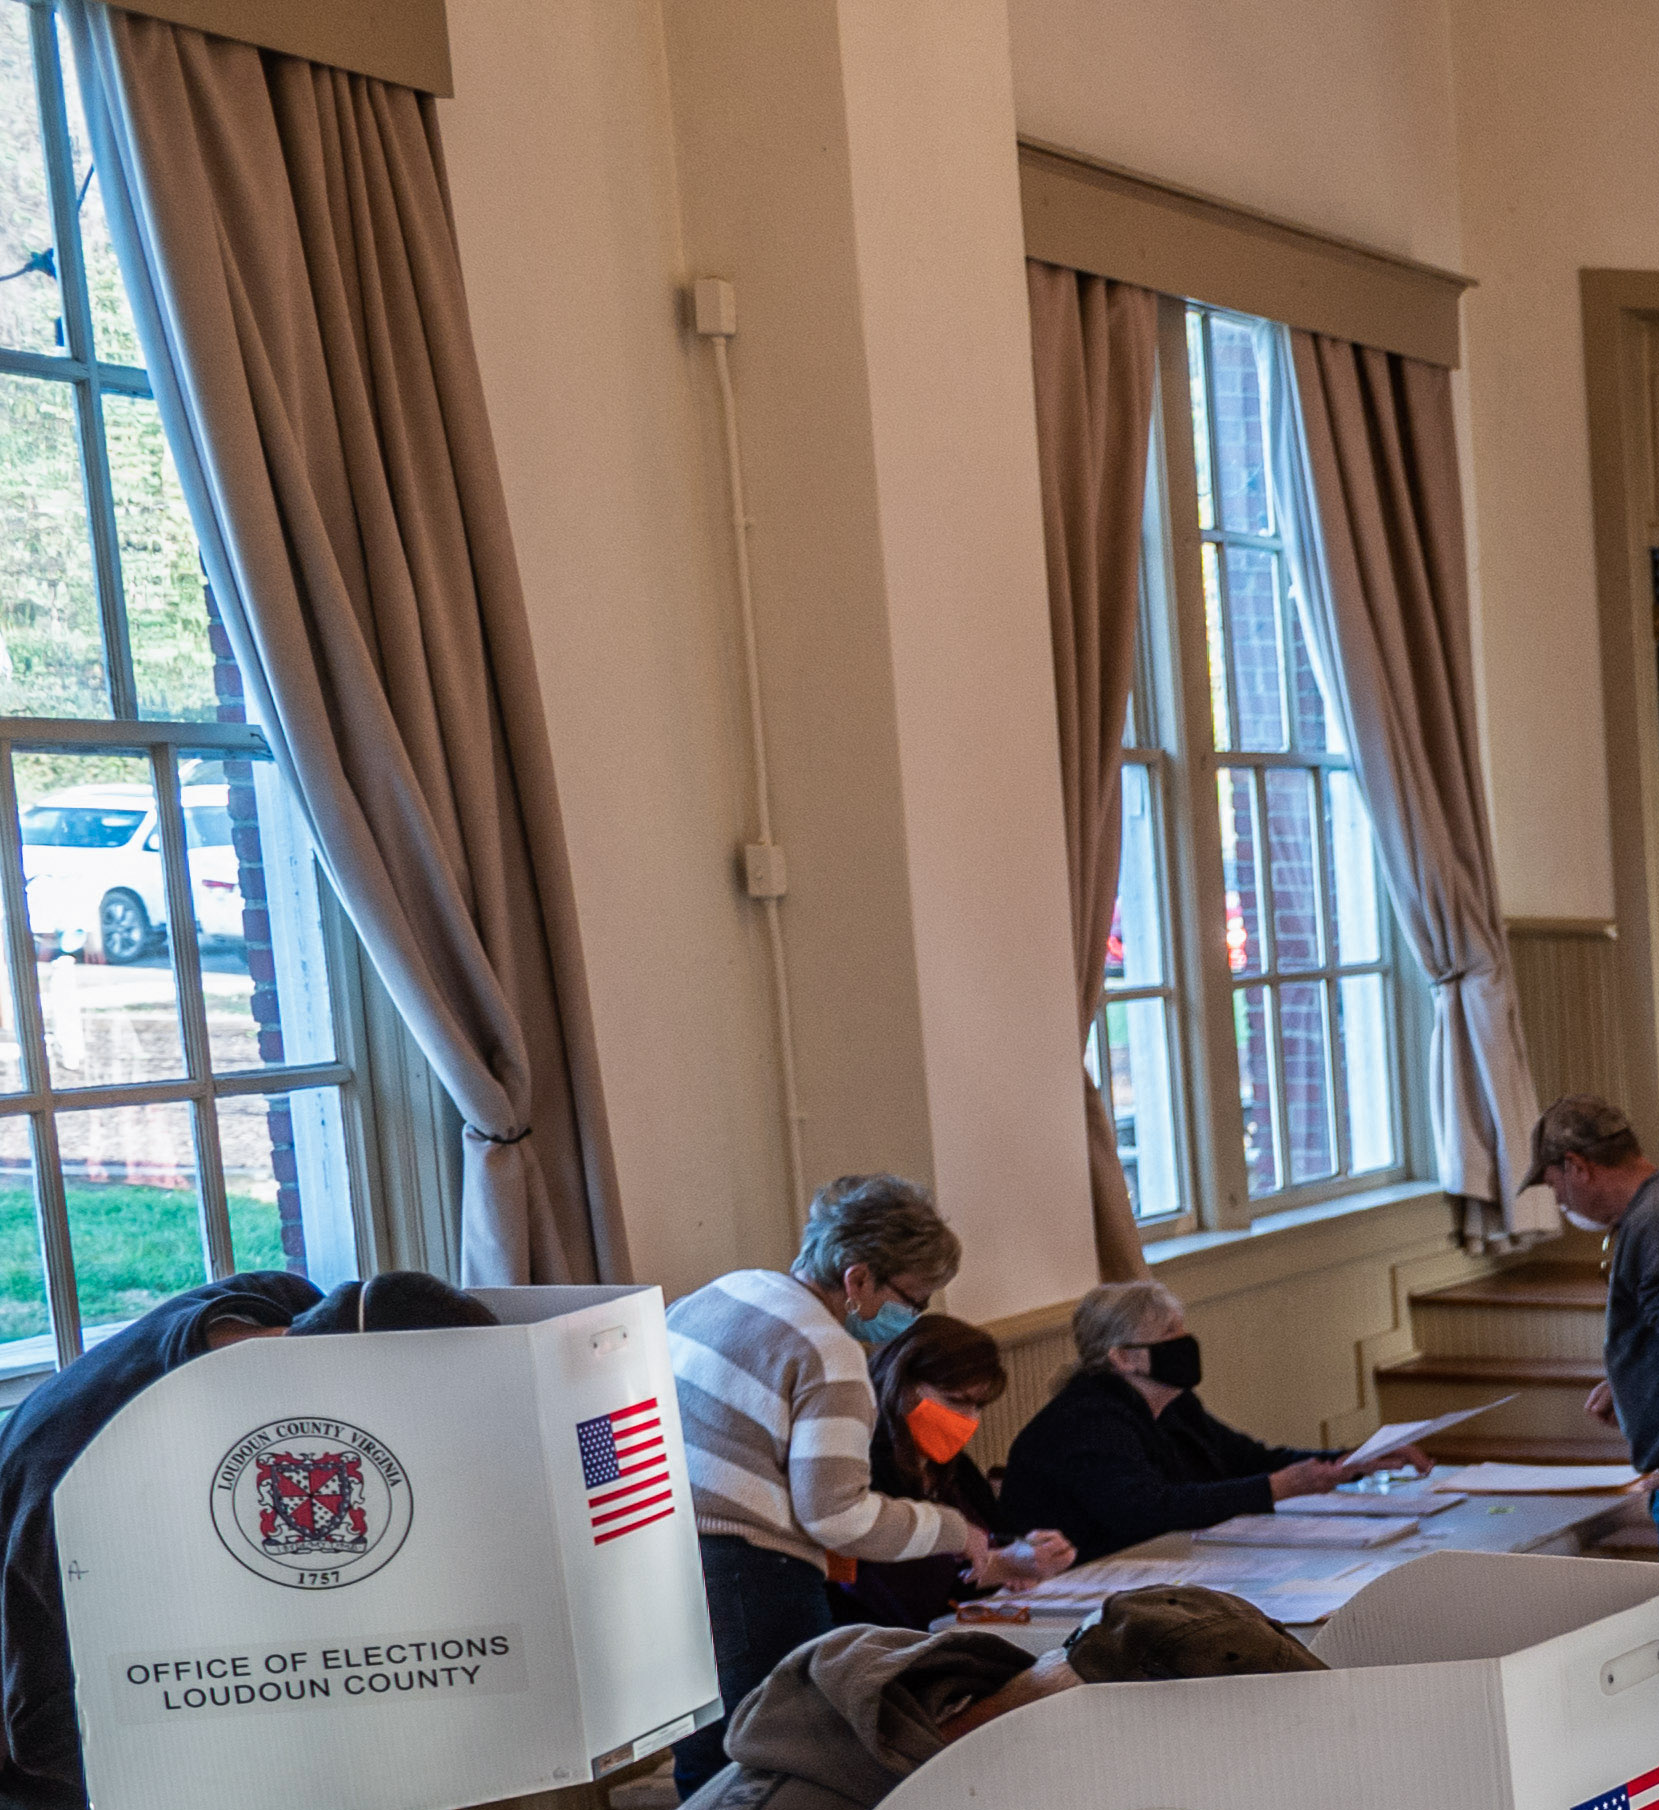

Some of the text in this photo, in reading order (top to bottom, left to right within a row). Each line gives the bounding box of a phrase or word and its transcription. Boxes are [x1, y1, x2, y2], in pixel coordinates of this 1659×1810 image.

[218, 1422, 402, 1491] LOUDOUN COUNTY VIRGINIA
[299, 1571, 340, 1585] 1757
[127, 1636, 510, 1684] OFFICE OF ELECTIONS
[163, 1666, 481, 1709] LOUDOUN COUNTY
